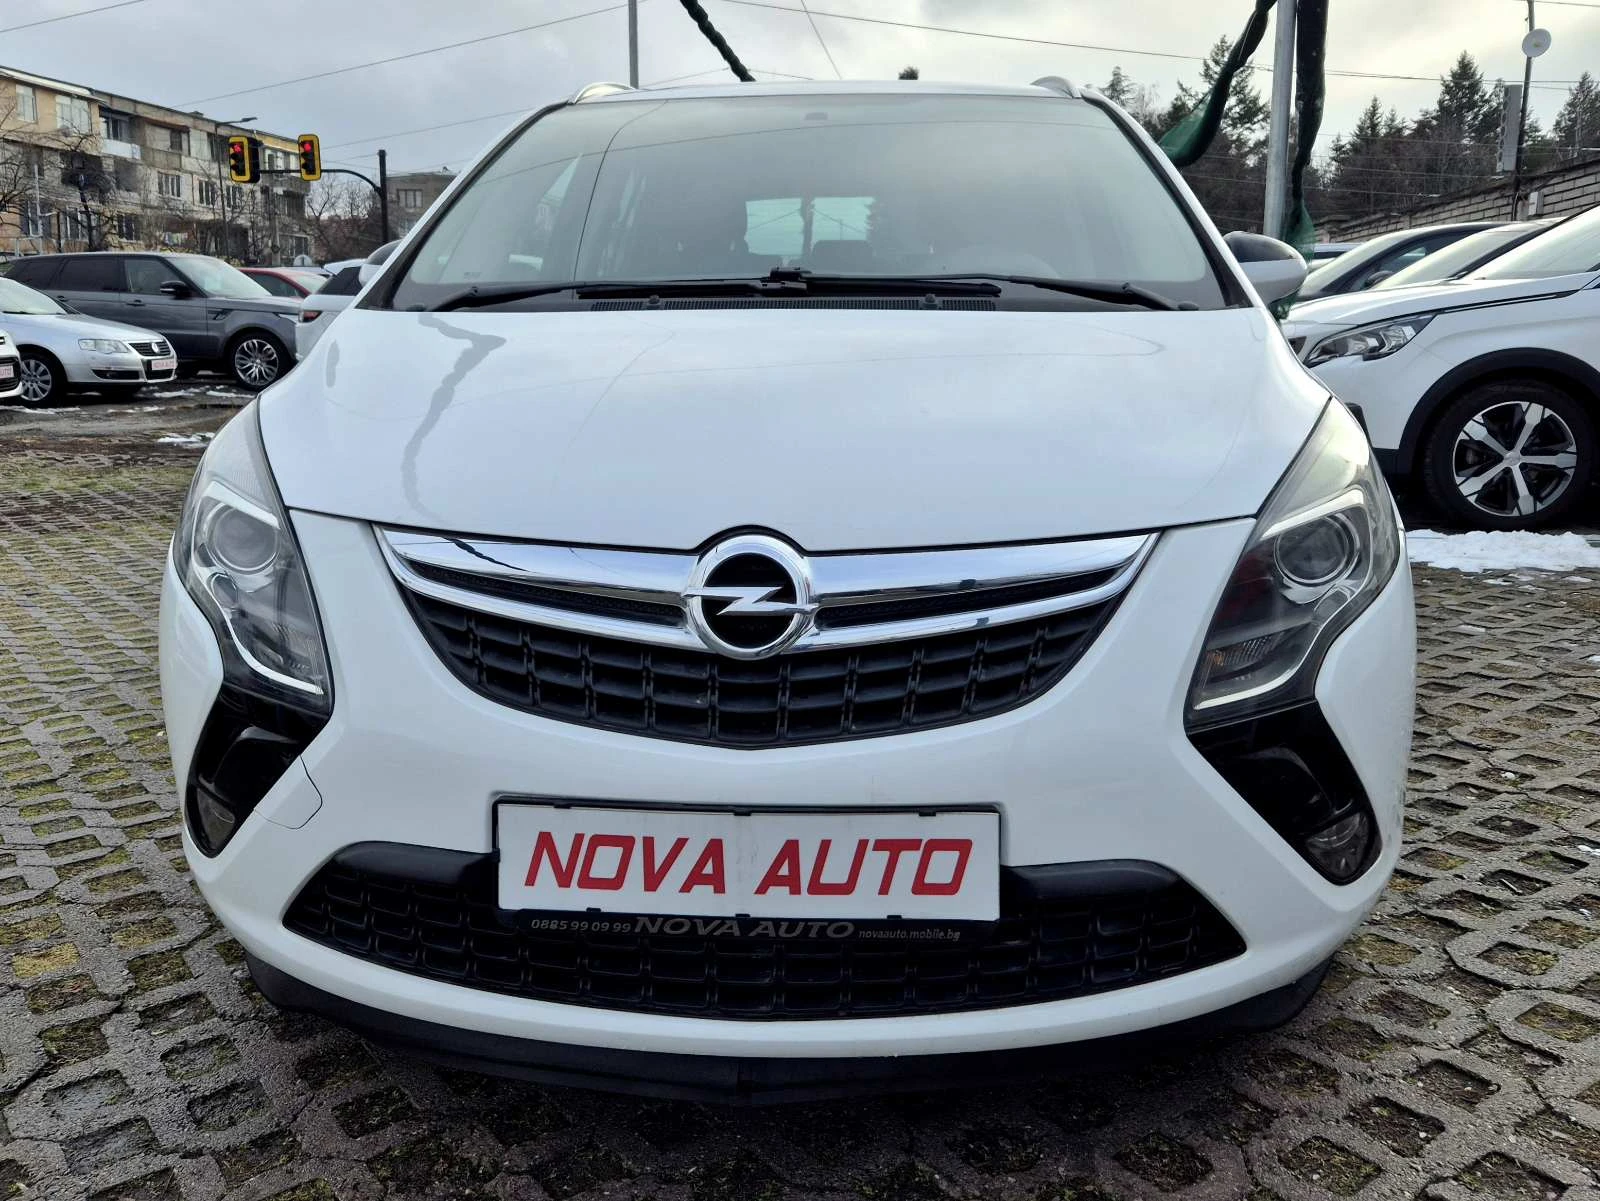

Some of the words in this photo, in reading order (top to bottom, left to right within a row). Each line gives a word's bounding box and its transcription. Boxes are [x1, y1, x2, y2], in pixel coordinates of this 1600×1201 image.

[525, 831, 726, 894] NOVA
[753, 838, 973, 897] AUTO
[531, 919, 568, 930] 0885
[570, 920, 588, 931] 99
[591, 921, 610, 932] 09
[612, 922, 631, 933] 99
[634, 916, 741, 937] NOVA
[749, 920, 855, 938] AUTO
[859, 928, 961, 941] novaauto.mobile.bg
